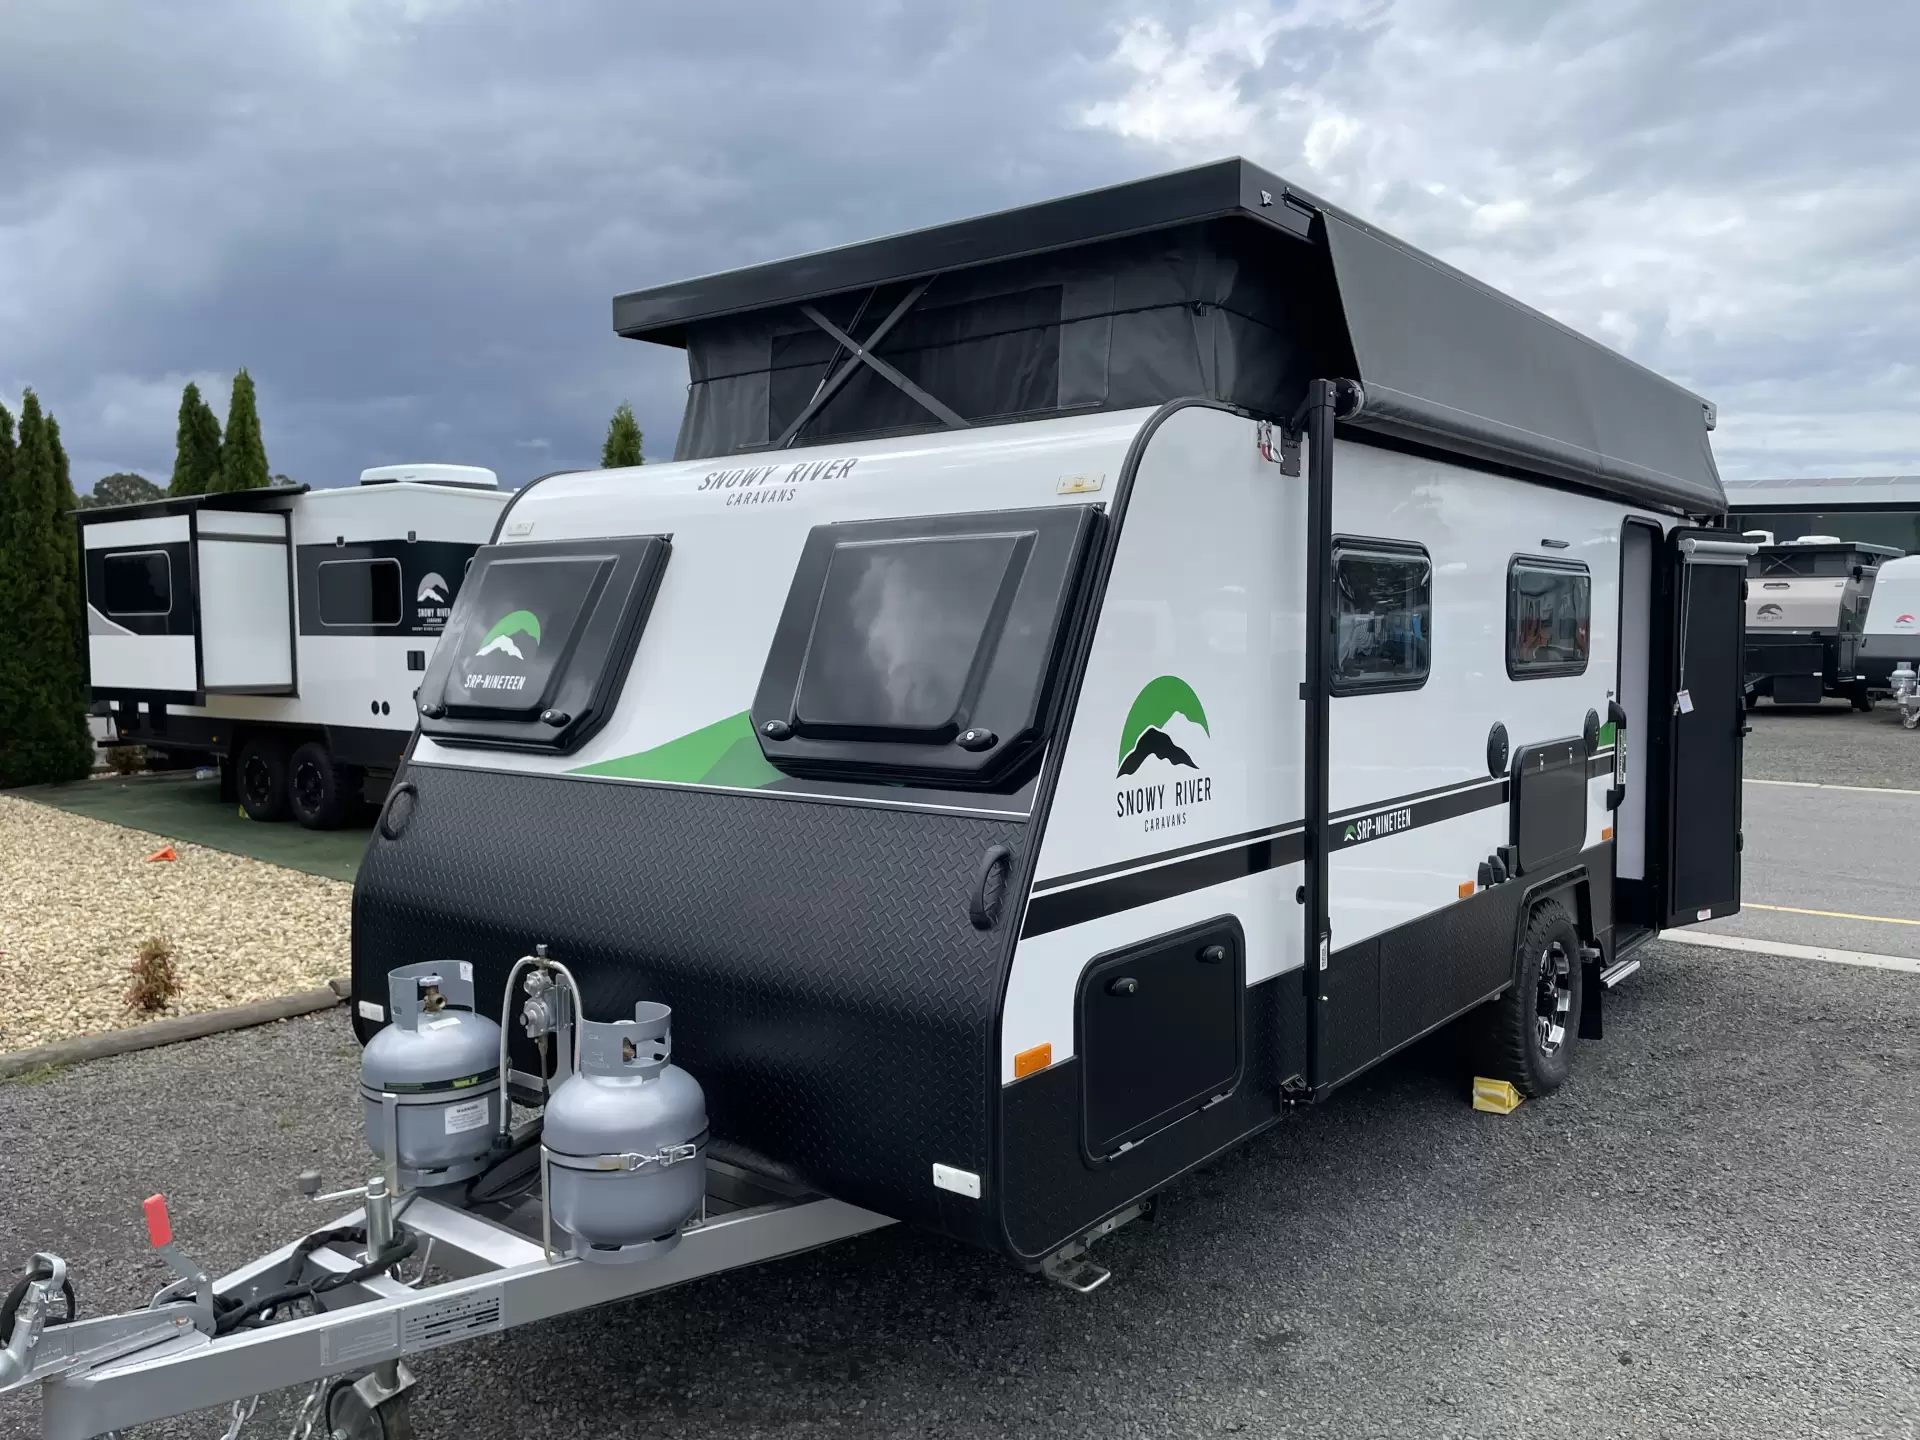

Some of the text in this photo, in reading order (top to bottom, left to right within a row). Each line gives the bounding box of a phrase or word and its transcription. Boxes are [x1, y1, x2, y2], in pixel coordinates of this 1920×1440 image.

[697, 457, 859, 492] SNOWY RIVER
[726, 488, 796, 506] CARAVANS
[464, 674, 527, 690] SRP-NINETEEN
[1116, 776, 1212, 818] SNOWY RIVER
[1144, 812, 1187, 833] CARAVANS
[1356, 807, 1411, 841] SRP-NINETEEN
